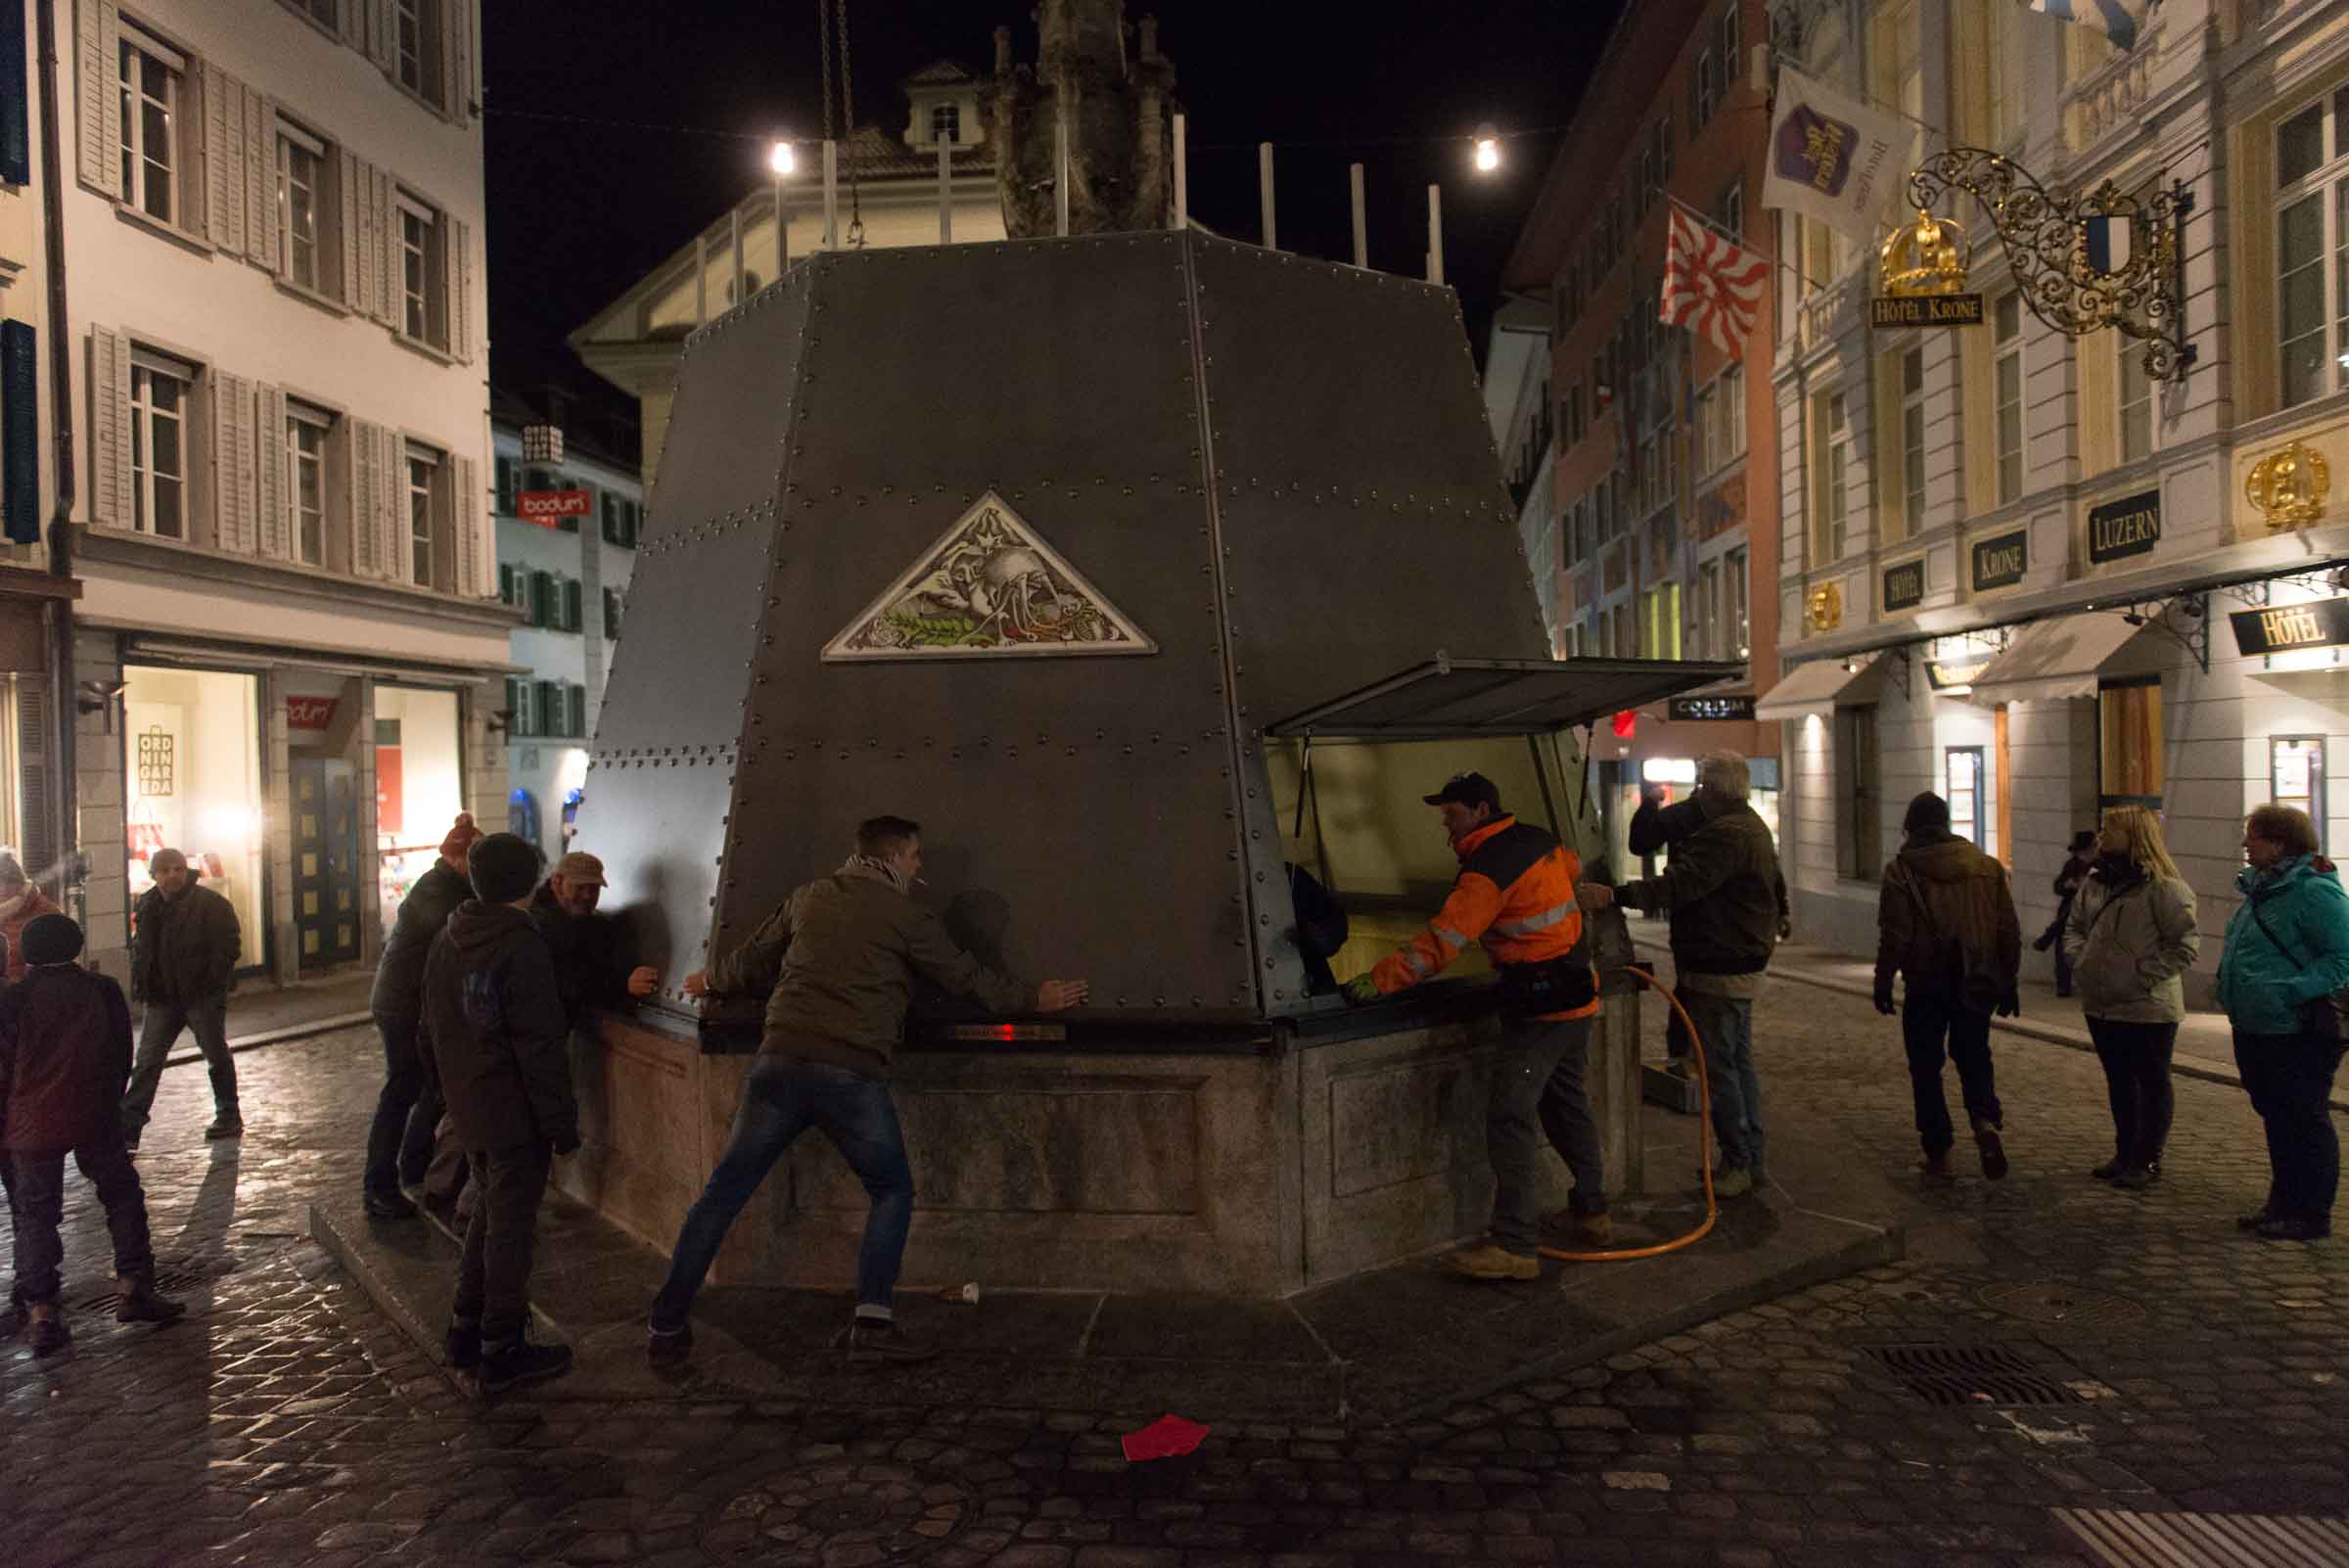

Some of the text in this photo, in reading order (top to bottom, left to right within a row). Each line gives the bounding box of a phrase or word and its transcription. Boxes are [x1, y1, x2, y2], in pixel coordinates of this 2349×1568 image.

[1928, 298, 1979, 319] KRONE
[525, 495, 585, 514] bodum
[2095, 508, 2160, 551] LUZERN
[1980, 545, 2022, 580] KRONE
[140, 736, 172, 752] ORD
[140, 751, 172, 765] NIN
